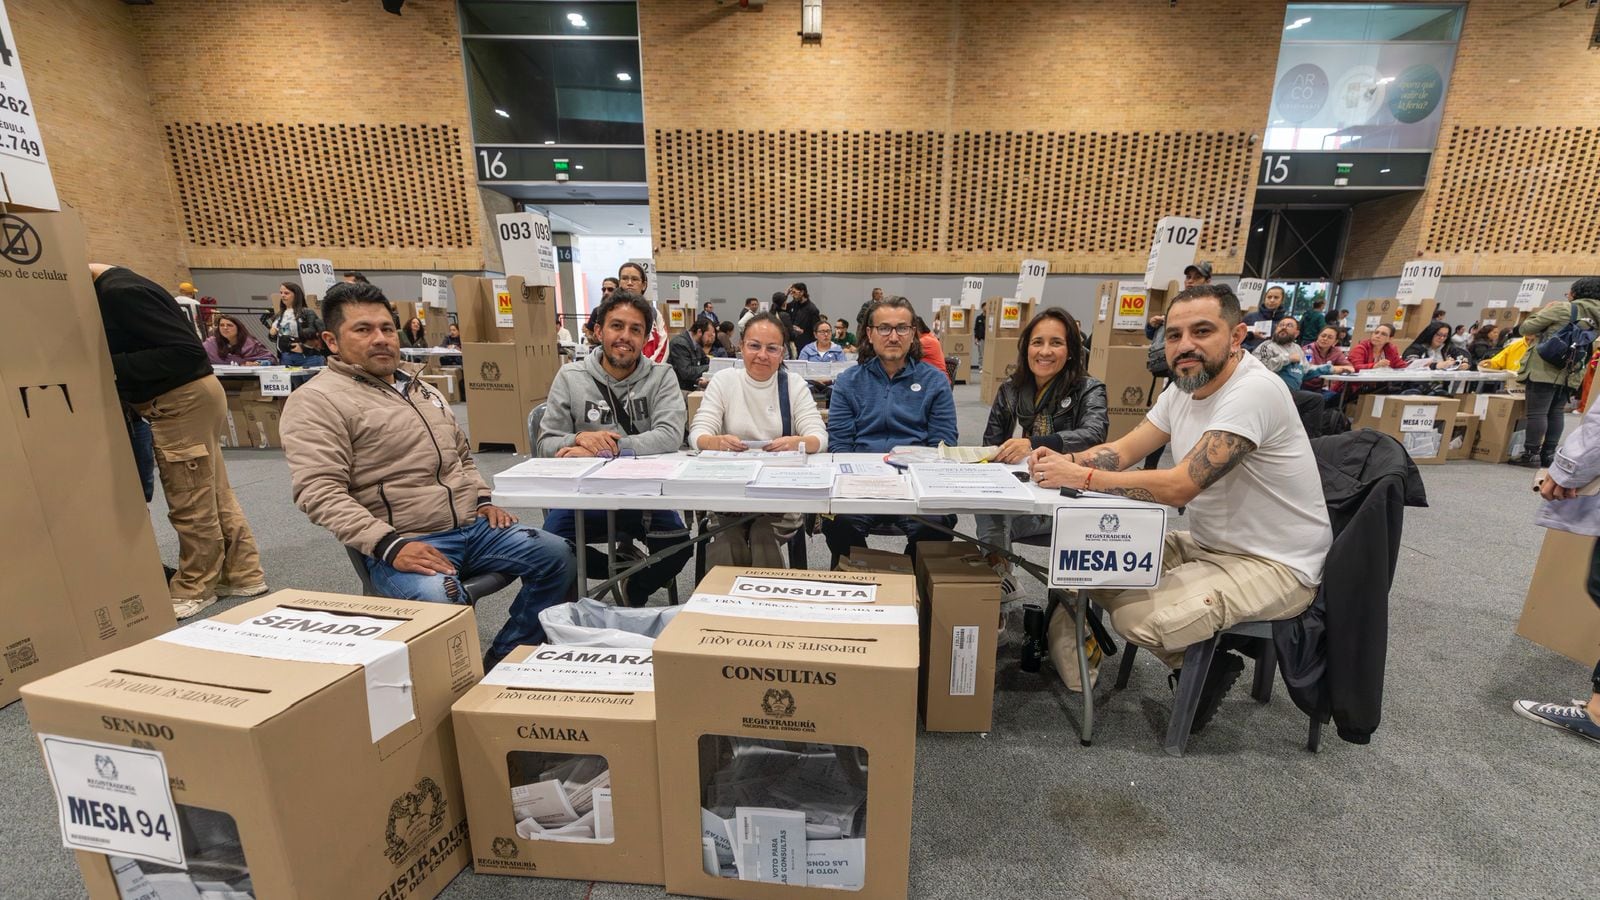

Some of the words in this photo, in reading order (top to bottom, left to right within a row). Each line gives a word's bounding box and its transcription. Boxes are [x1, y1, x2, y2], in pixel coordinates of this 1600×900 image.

[1291, 86, 1313, 100] CO
[479, 150, 508, 179] 16
[1264, 155, 1291, 184] 15
[500, 221, 532, 241] 093
[534, 221, 550, 242] 093
[1167, 225, 1199, 246] 102
[559, 249, 571, 260] 16
[15, 268, 29, 279] de
[32, 269, 68, 281] celular
[300, 263, 321, 274] 083
[1028, 264, 1046, 277] 101
[1404, 265, 1420, 278] 110
[1422, 265, 1442, 278] 110
[422, 276, 437, 288] 082
[680, 279, 694, 288] 091
[968, 280, 982, 290] 100
[1249, 282, 1263, 291] 109
[1521, 282, 1535, 291] 118
[1059, 549, 1118, 572] MESA
[1123, 551, 1153, 572] 94
[738, 583, 868, 598] CONSULTA
[253, 615, 384, 637] SENADO
[737, 638, 773, 649] VOTO
[776, 641, 795, 650] SU
[798, 643, 867, 654] DEPOSITE
[721, 665, 837, 686] CONSULTAS
[527, 693, 557, 701] VOTO
[560, 695, 575, 703] SU
[576, 695, 634, 705] DEPOSITE
[101, 715, 174, 741] SENADO
[742, 716, 816, 728] REGISTRADURÍA
[516, 723, 590, 742] CÁMARA
[67, 796, 135, 834] MESA
[136, 809, 172, 842] 94
[408, 872, 428, 893] DEL
[429, 838, 463, 873] ESTADO
